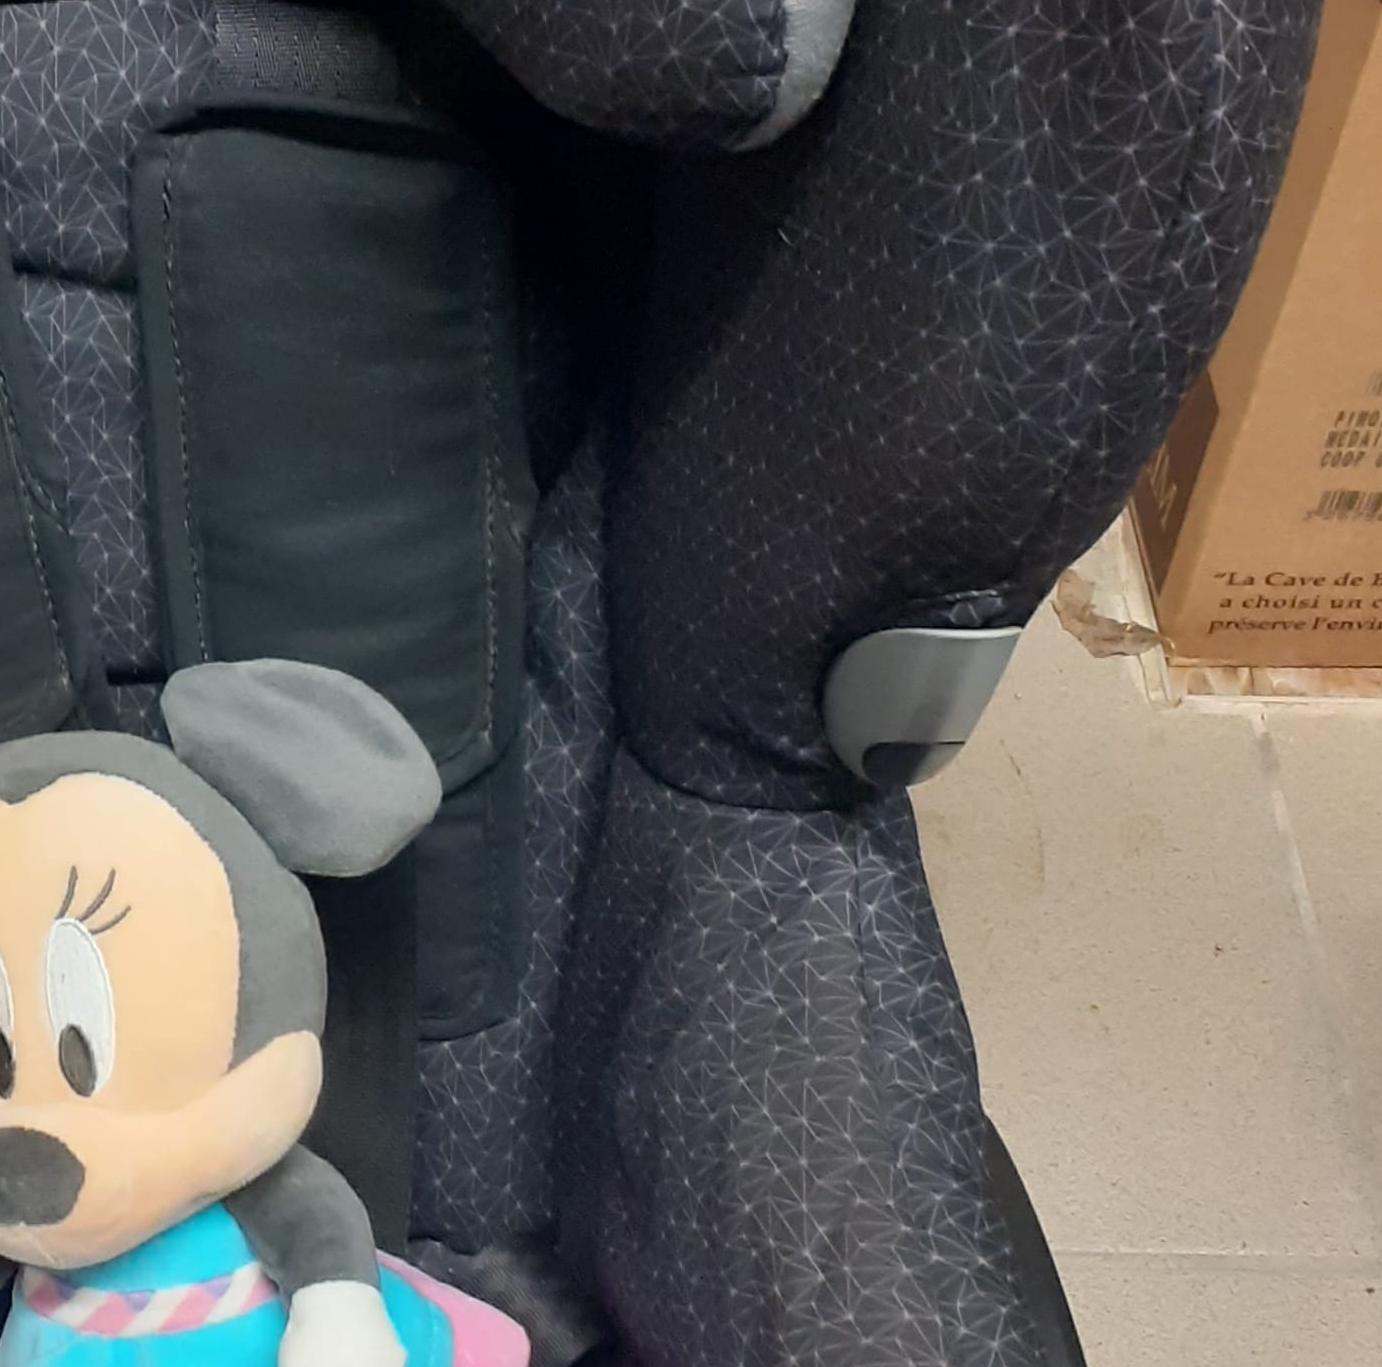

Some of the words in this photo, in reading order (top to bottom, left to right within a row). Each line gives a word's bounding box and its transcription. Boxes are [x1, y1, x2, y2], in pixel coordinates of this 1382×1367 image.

[1265, 572, 1326, 587] Cave
[1335, 572, 1363, 587] de
[1219, 598, 1233, 609] a
[1242, 595, 1321, 609] choisi
[1330, 599, 1362, 609] un
[1207, 619, 1307, 635] préserve
